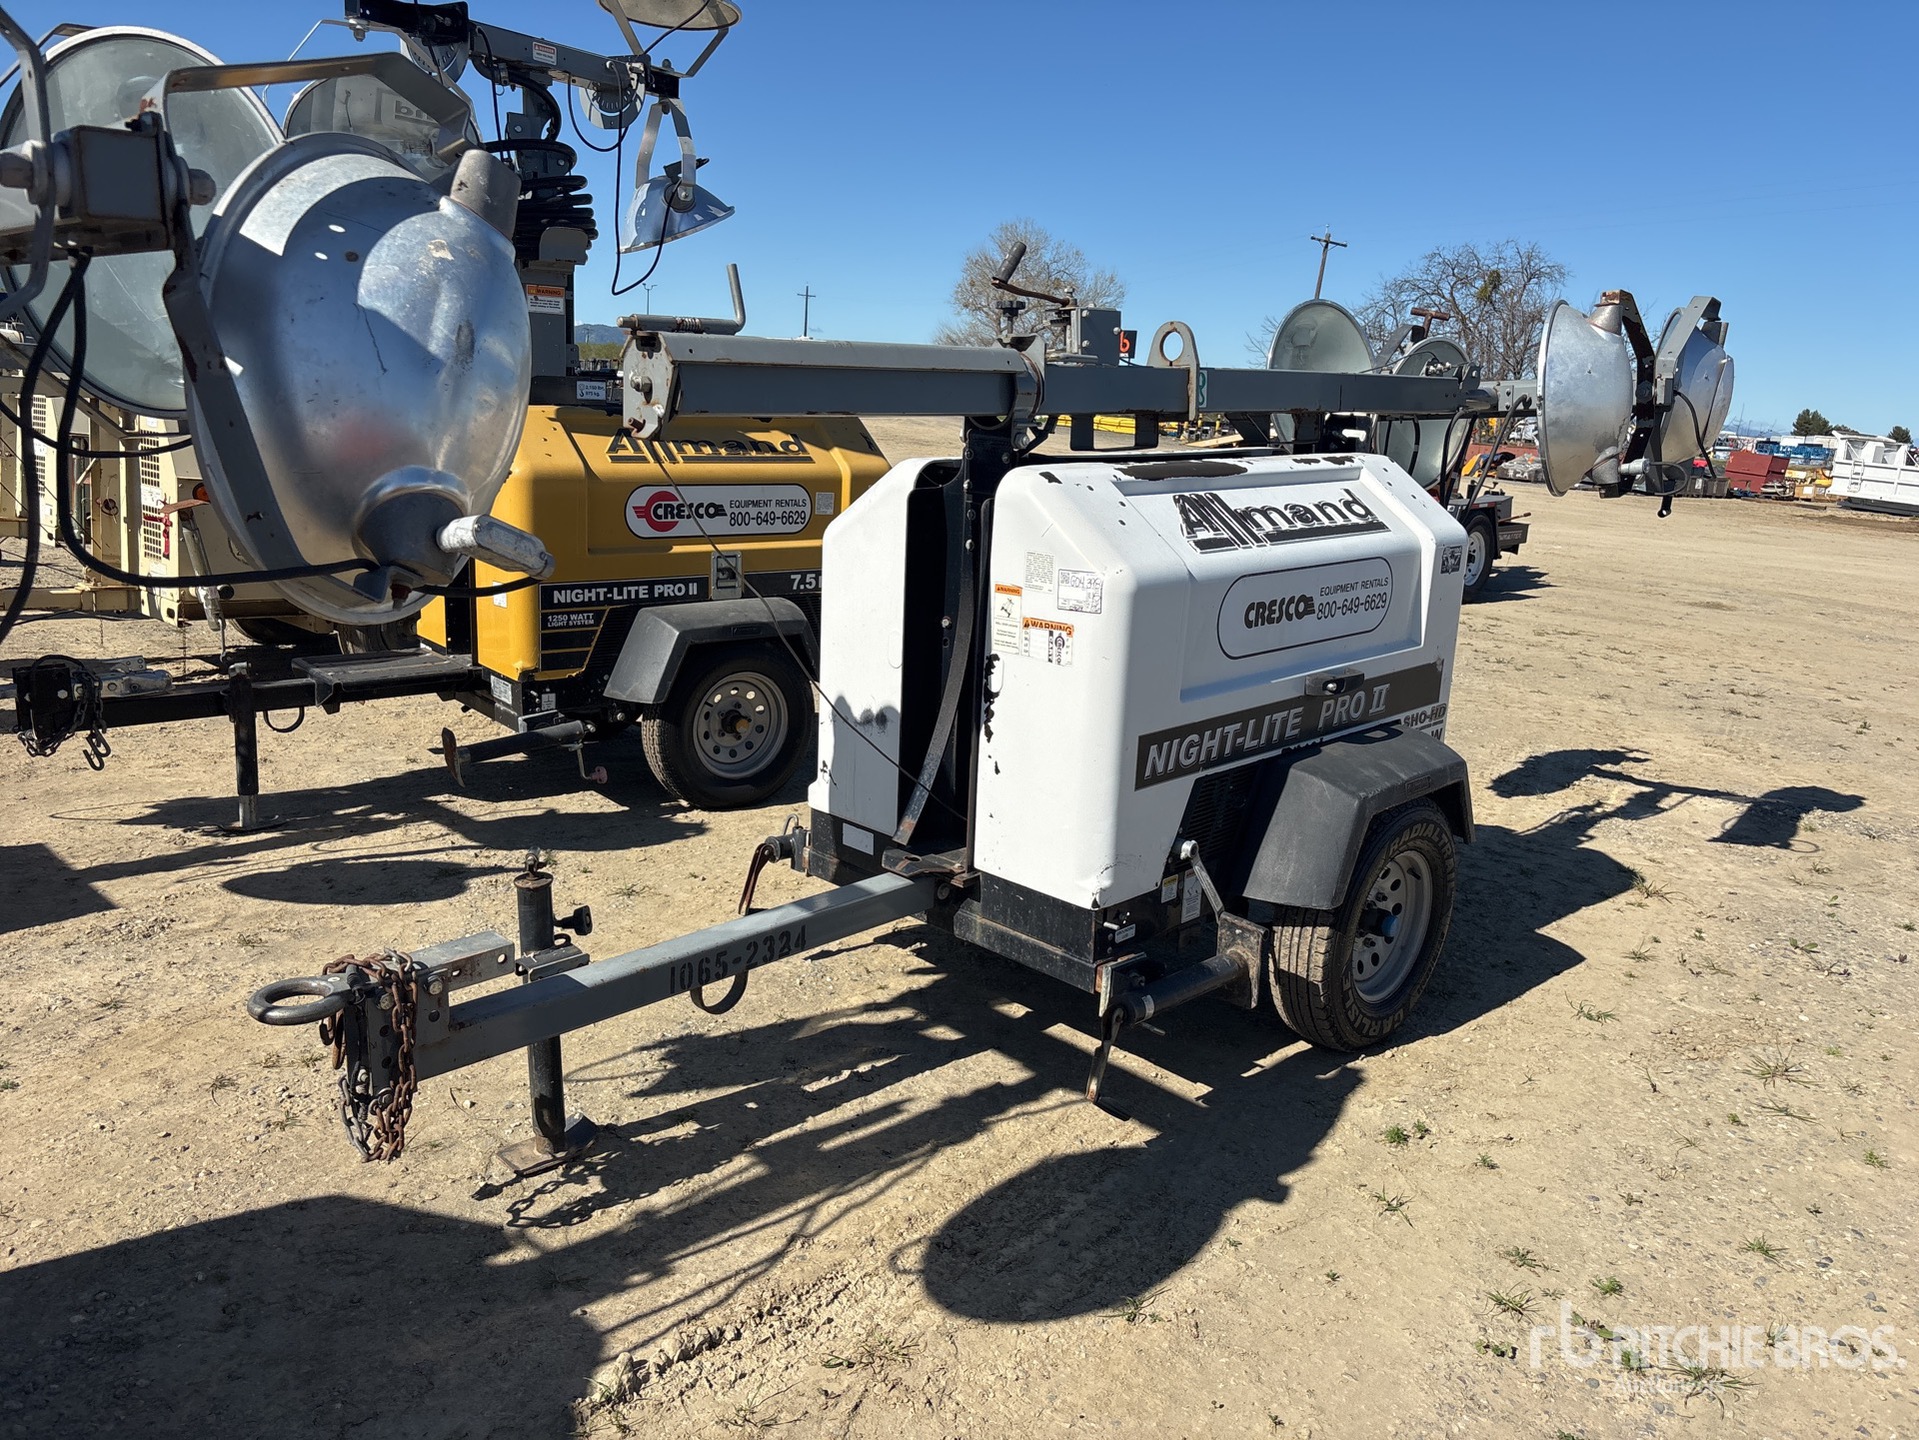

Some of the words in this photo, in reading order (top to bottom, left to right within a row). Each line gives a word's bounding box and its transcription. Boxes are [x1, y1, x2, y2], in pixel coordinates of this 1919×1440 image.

[537, 288, 562, 296] WARNING
[606, 428, 812, 463] Allmand
[652, 503, 721, 520] CRESCO
[729, 499, 773, 509] EQUIPMENT
[775, 498, 808, 508] RENTALS
[729, 510, 807, 527] 800-649-6629
[1172, 488, 1382, 549] Allmand
[553, 585, 649, 604] NIGHT-LITE
[654, 583, 686, 598] PRO
[688, 582, 698, 595] II
[1319, 582, 1360, 597] EQUIPMENT
[1361, 577, 1389, 590] RENTALS
[1244, 594, 1311, 630] CRESCO
[1316, 593, 1388, 621] 800-649-6629
[547, 614, 568, 622] 1250
[570, 612, 594, 621] WATT
[569, 619, 594, 627] SYSTEM
[1030, 620, 1072, 636] WARNING
[1144, 706, 1305, 780] NIGHT-LITE
[1318, 691, 1366, 731] PRO
[1369, 683, 1391, 717] II
